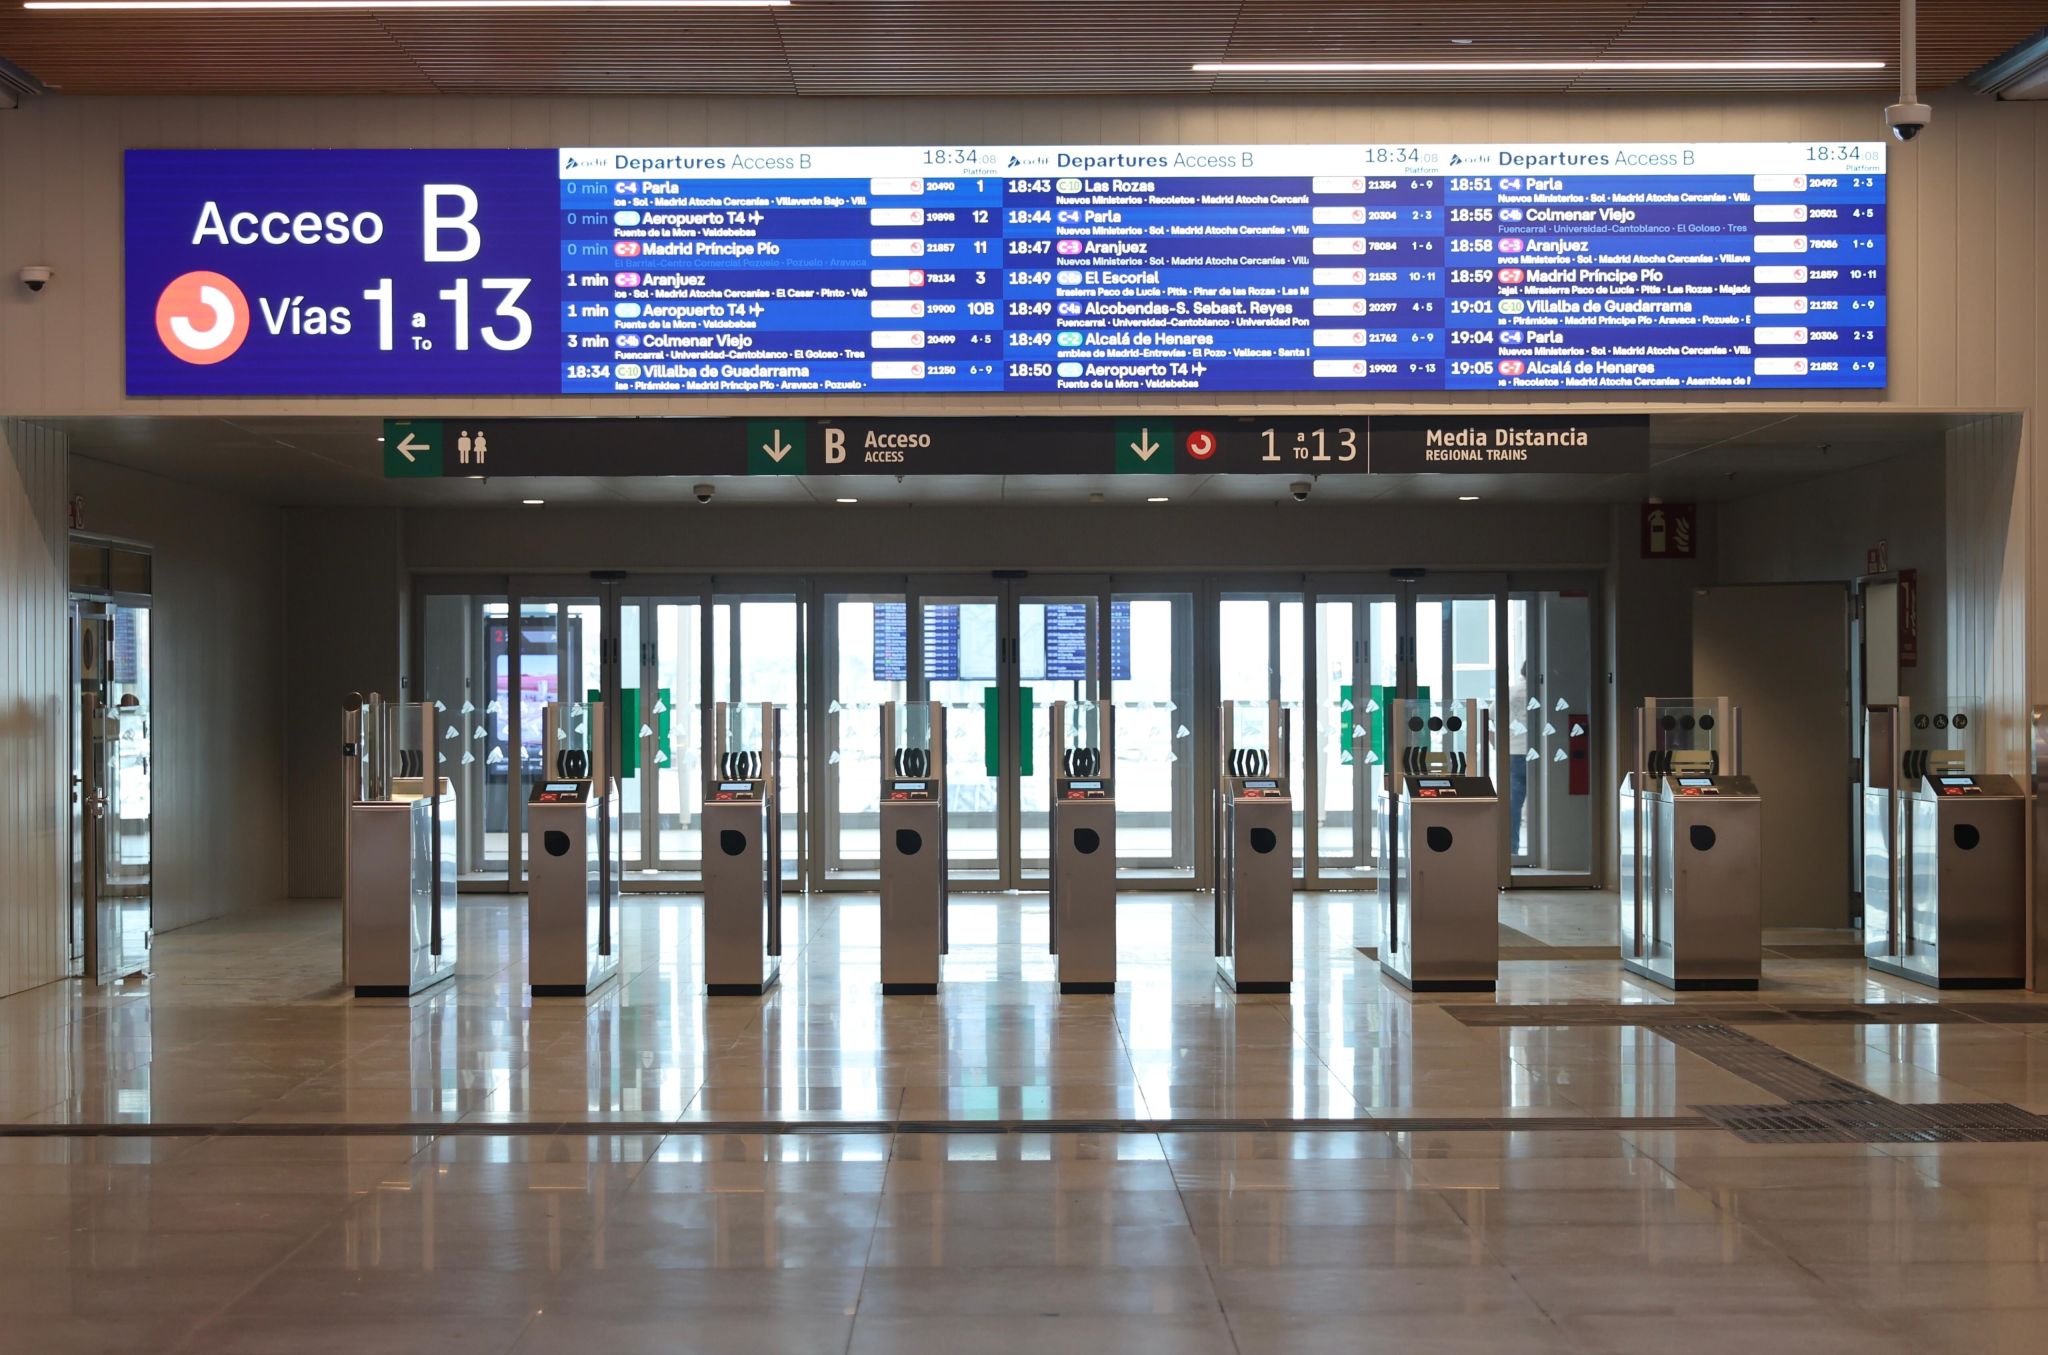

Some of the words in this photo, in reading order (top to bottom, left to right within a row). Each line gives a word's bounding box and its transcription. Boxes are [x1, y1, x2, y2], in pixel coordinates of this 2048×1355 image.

[616, 155, 725, 172] Departures
[732, 154, 794, 169] Access
[800, 154, 811, 169] B
[1058, 154, 1167, 170] Departures
[1174, 153, 1236, 167] Access
[1242, 152, 1253, 167] B
[1500, 152, 1608, 169] Departures
[1615, 151, 1677, 165] Access
[1684, 150, 1694, 165] B
[568, 183, 576, 193] 0
[582, 182, 607, 193] min
[616, 183, 637, 193] C-4
[643, 181, 679, 194] Parla
[977, 180, 983, 192] 1
[1009, 180, 1051, 192] 18:43
[1085, 180, 1109, 192] Las
[1113, 179, 1155, 192] Rozas
[1451, 178, 1492, 191] 18:51
[1500, 179, 1520, 190] C-4
[1527, 178, 1562, 190] Parla
[192, 202, 383, 244] Acceso
[424, 184, 480, 262] B
[568, 213, 576, 224] 0
[583, 212, 607, 224] min
[642, 212, 724, 227] Aeropuerto
[727, 212, 745, 224] T4
[973, 210, 988, 223] 12
[1009, 210, 1051, 223] 18:44
[1059, 212, 1079, 222] C-4
[1085, 210, 1121, 223] Parla
[1451, 209, 1492, 221] 18:55
[1526, 208, 1596, 221] Colmenar
[1599, 208, 1635, 223] Viejo
[614, 228, 646, 237] Fuente
[647, 228, 660, 237] de
[1499, 225, 1547, 233] Fuencarral
[1554, 225, 1670, 233] Universidad-Cantoblanco
[1678, 224, 1686, 232] El
[1688, 224, 1720, 232] Goloso
[1727, 224, 1747, 232] Tres
[568, 244, 576, 255] 0
[583, 243, 608, 255] min
[643, 242, 692, 255] Madrid
[696, 242, 754, 257] Príncipe
[757, 242, 779, 254] Pío
[974, 241, 986, 253] 11
[1009, 241, 1051, 254] 18:47
[1085, 241, 1147, 256] Aranjuez
[1451, 239, 1493, 252] 18:58
[1526, 239, 1588, 254] Aranjuez
[1171, 257, 1203, 265] Madrid
[1205, 257, 1238, 265] Atocha
[568, 274, 577, 286] 1
[582, 273, 608, 286] min
[643, 273, 705, 288] Aranjuez
[976, 272, 985, 284] 3
[1010, 272, 1051, 284] 18:49
[1086, 271, 1099, 284] El
[1103, 271, 1159, 284] Escorial
[1451, 270, 1493, 282] 18:59
[1502, 271, 1522, 281] C-7
[1527, 269, 1576, 282] Madrid
[1580, 269, 1637, 284] Príncipe
[1641, 269, 1663, 281] Pío
[568, 304, 577, 317] 1
[582, 304, 608, 316] min
[643, 304, 724, 319] Aeropuerto
[727, 304, 746, 316] T4
[968, 302, 994, 315] 10B
[1010, 302, 1051, 315] 18:49
[1085, 301, 1189, 314] Alcobendas-S.
[1194, 301, 1246, 314] Sebast.
[1250, 301, 1292, 316] Reyes
[1452, 301, 1492, 313] 19:01
[1527, 300, 1580, 312] Villalba
[1583, 300, 1601, 312] de
[1605, 299, 1692, 312] Guadarrama
[260, 296, 351, 334] Vías
[364, 279, 392, 350] 1
[412, 313, 425, 327] a
[440, 278, 532, 350] 13
[412, 337, 432, 350] To
[568, 335, 577, 347] 3
[582, 334, 609, 347] min
[643, 334, 714, 347] Colmenar
[716, 334, 752, 349] Viejo
[1010, 333, 1051, 346] 18:49
[1086, 332, 1130, 345] Alcalá
[1133, 332, 1152, 345] de
[1155, 333, 1213, 345] Henares
[1451, 331, 1493, 343] 19:04
[1500, 333, 1521, 342] C-4
[1527, 330, 1563, 343] Parla
[568, 365, 610, 378] 18:34
[643, 365, 697, 377] Villalba
[700, 365, 718, 377] de
[721, 364, 809, 377] Guadarrama
[1010, 364, 1052, 376] 18:50
[1086, 363, 1166, 378] Aeropuerto
[1170, 363, 1188, 375] T4
[1452, 362, 1493, 374] 19:05
[1502, 363, 1522, 373] C-7
[1527, 361, 1571, 374] Alcalá
[1575, 361, 1593, 373] de
[1596, 361, 1654, 373] Henares
[865, 431, 930, 447] Acceso
[1262, 429, 1280, 460] 1
[1297, 433, 1304, 441] a
[1312, 428, 1356, 461] 13
[1427, 428, 1486, 446] Media
[1496, 428, 1587, 446] Distancia
[826, 429, 846, 463] B
[1293, 448, 1308, 459] TO
[865, 451, 904, 462] ACCESS
[1426, 450, 1483, 460] REGIONAL
[1486, 450, 1527, 460] TRAINS
